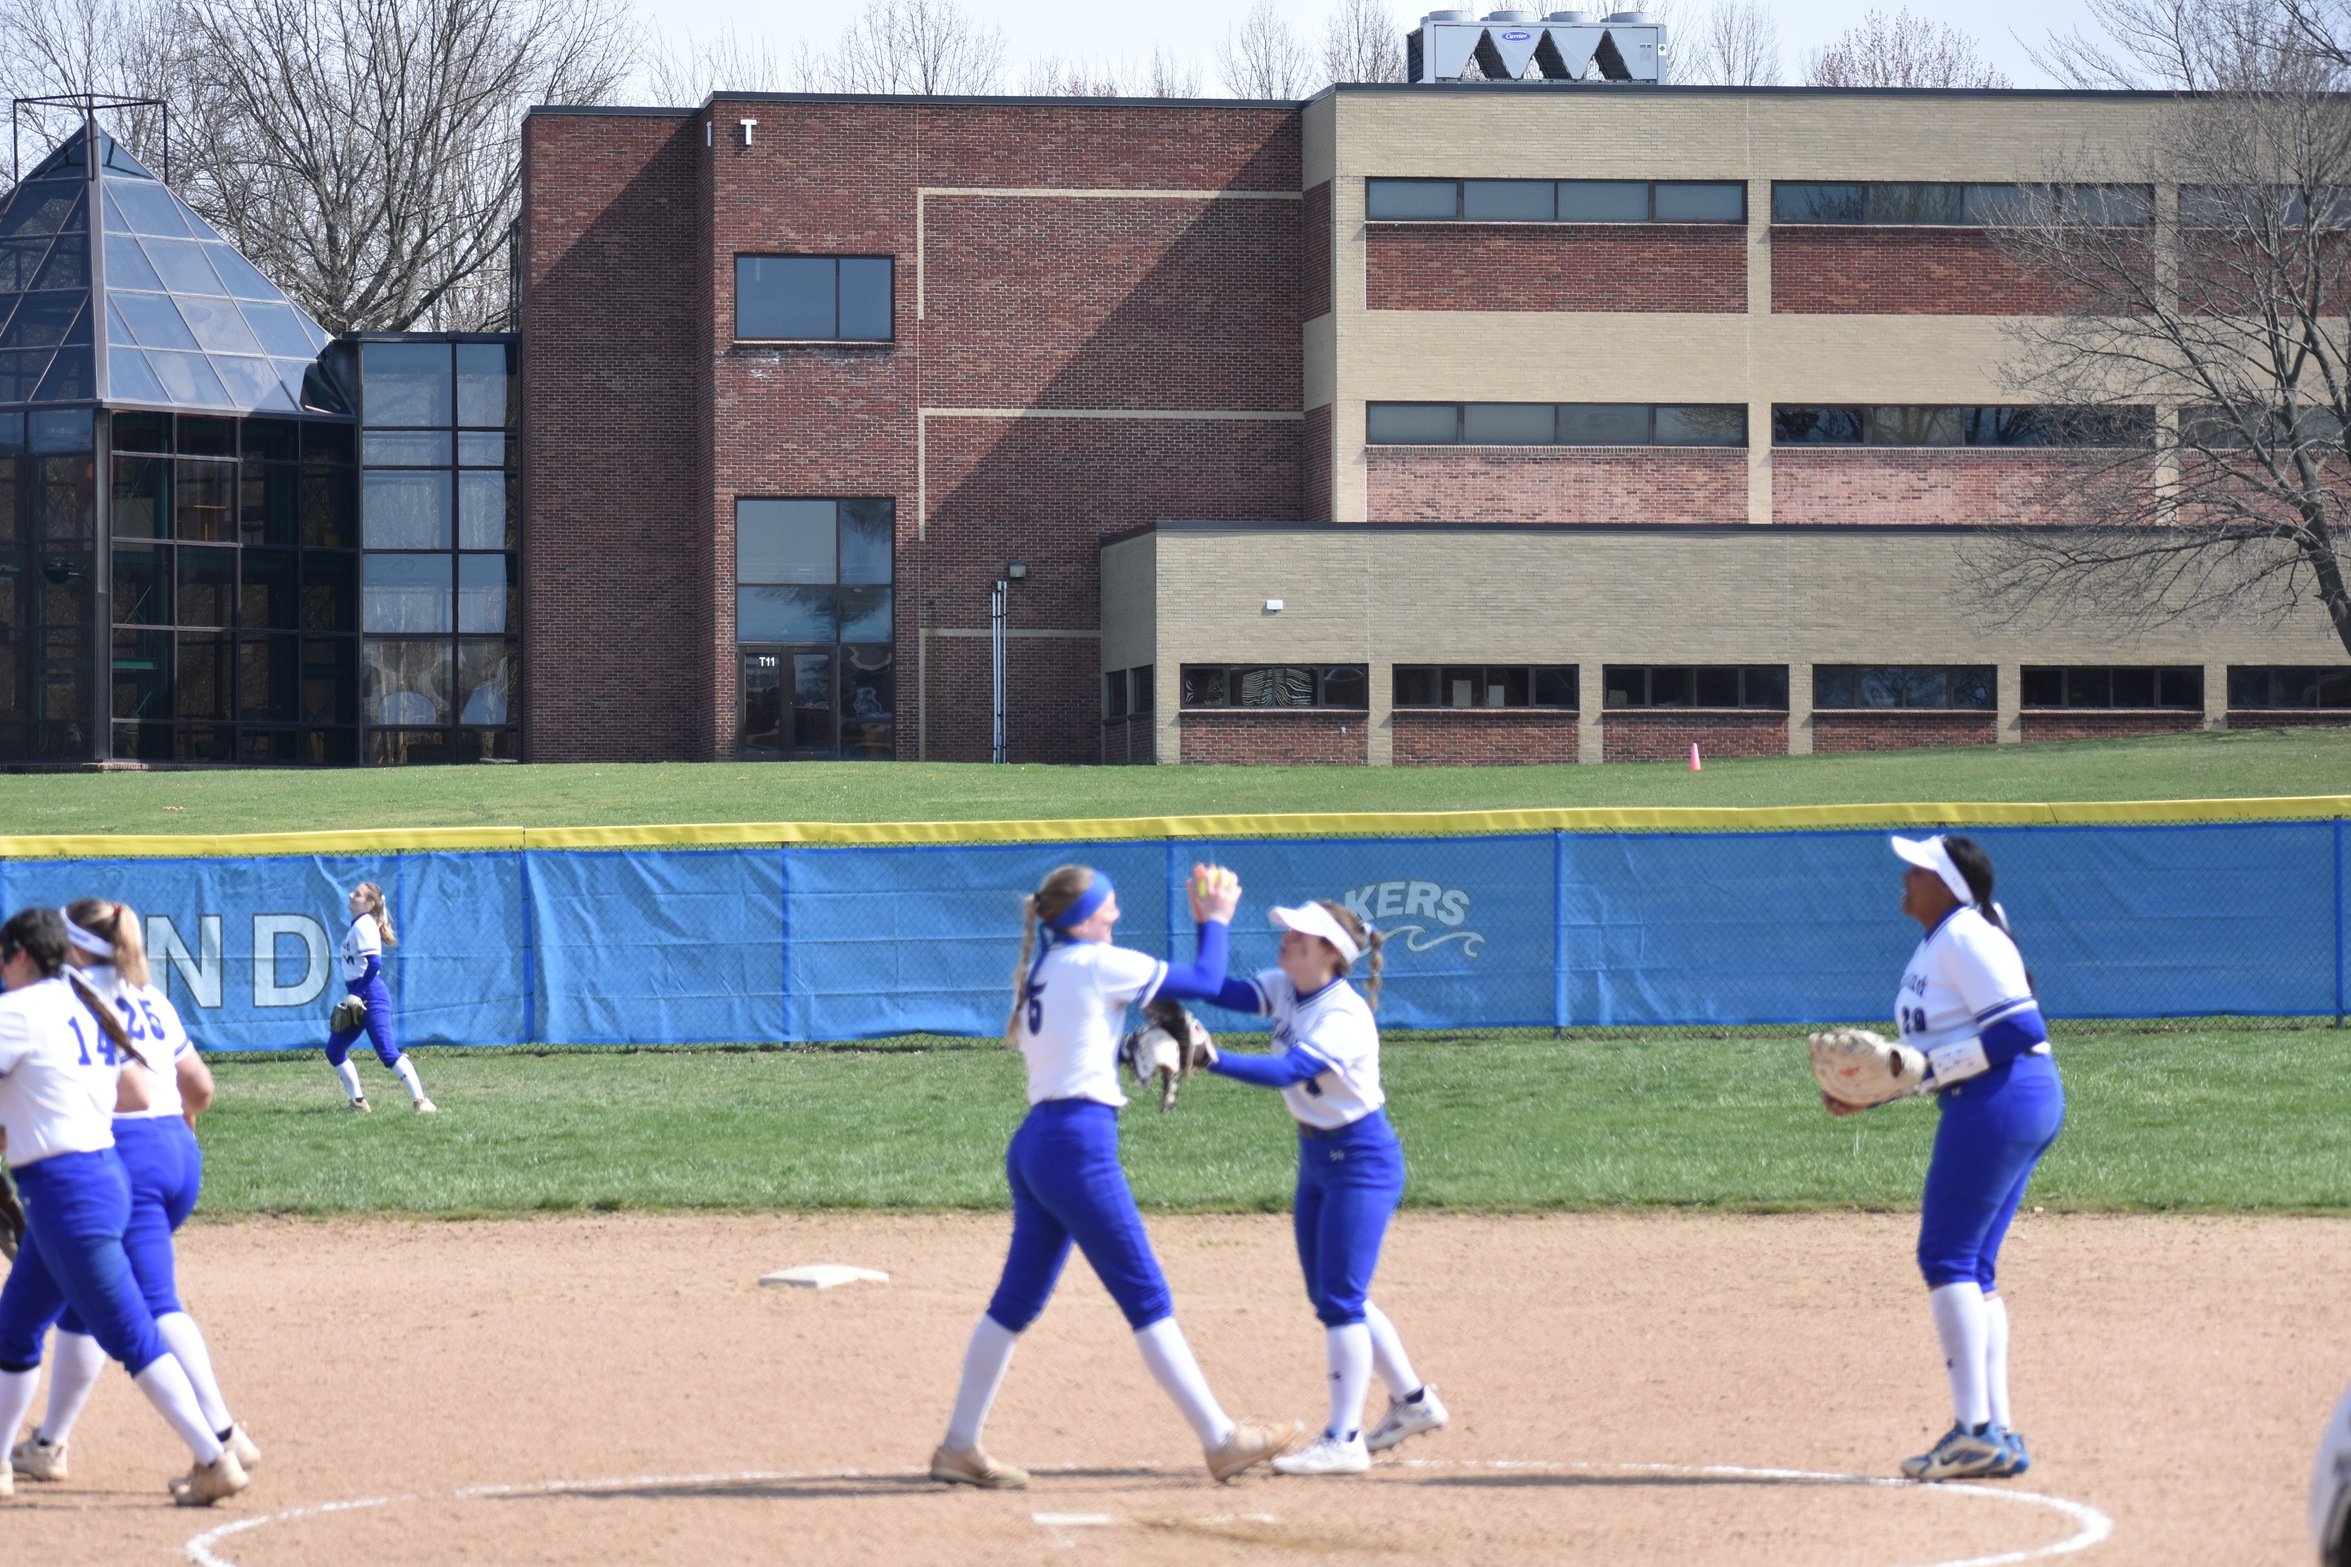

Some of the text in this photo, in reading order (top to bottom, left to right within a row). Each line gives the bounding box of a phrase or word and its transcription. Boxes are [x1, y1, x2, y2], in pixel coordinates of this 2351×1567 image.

[740, 119, 757, 145] T
[758, 656, 775, 667] T11
[1343, 880, 1471, 927] KERS
